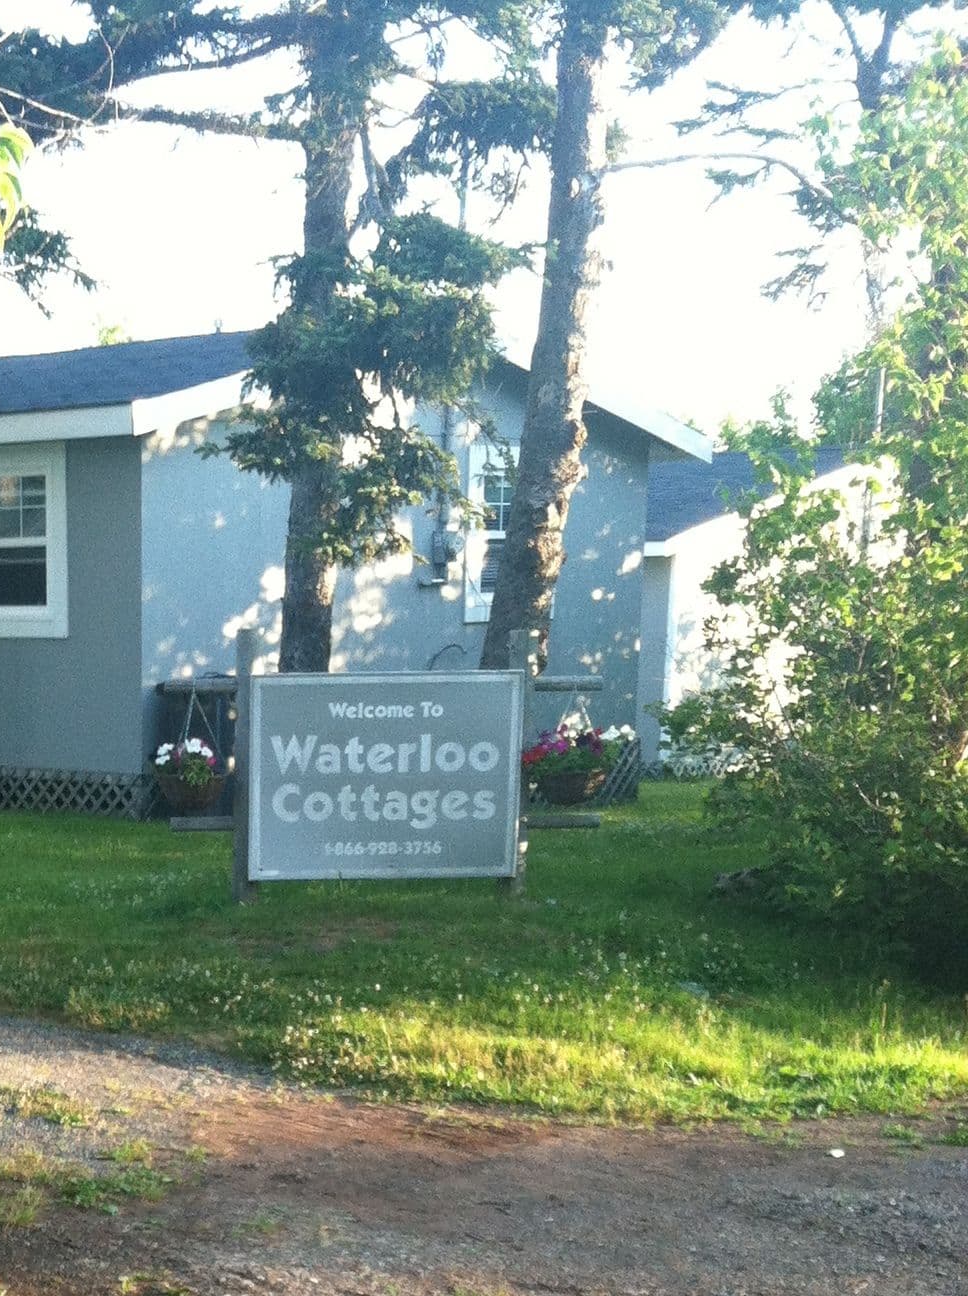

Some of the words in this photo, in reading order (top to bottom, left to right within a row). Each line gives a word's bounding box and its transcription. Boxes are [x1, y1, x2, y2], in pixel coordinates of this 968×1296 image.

[328, 701, 414, 719] Welcome
[420, 701, 444, 718] To
[270, 734, 500, 775] Waterloo
[271, 783, 497, 829] Cottages
